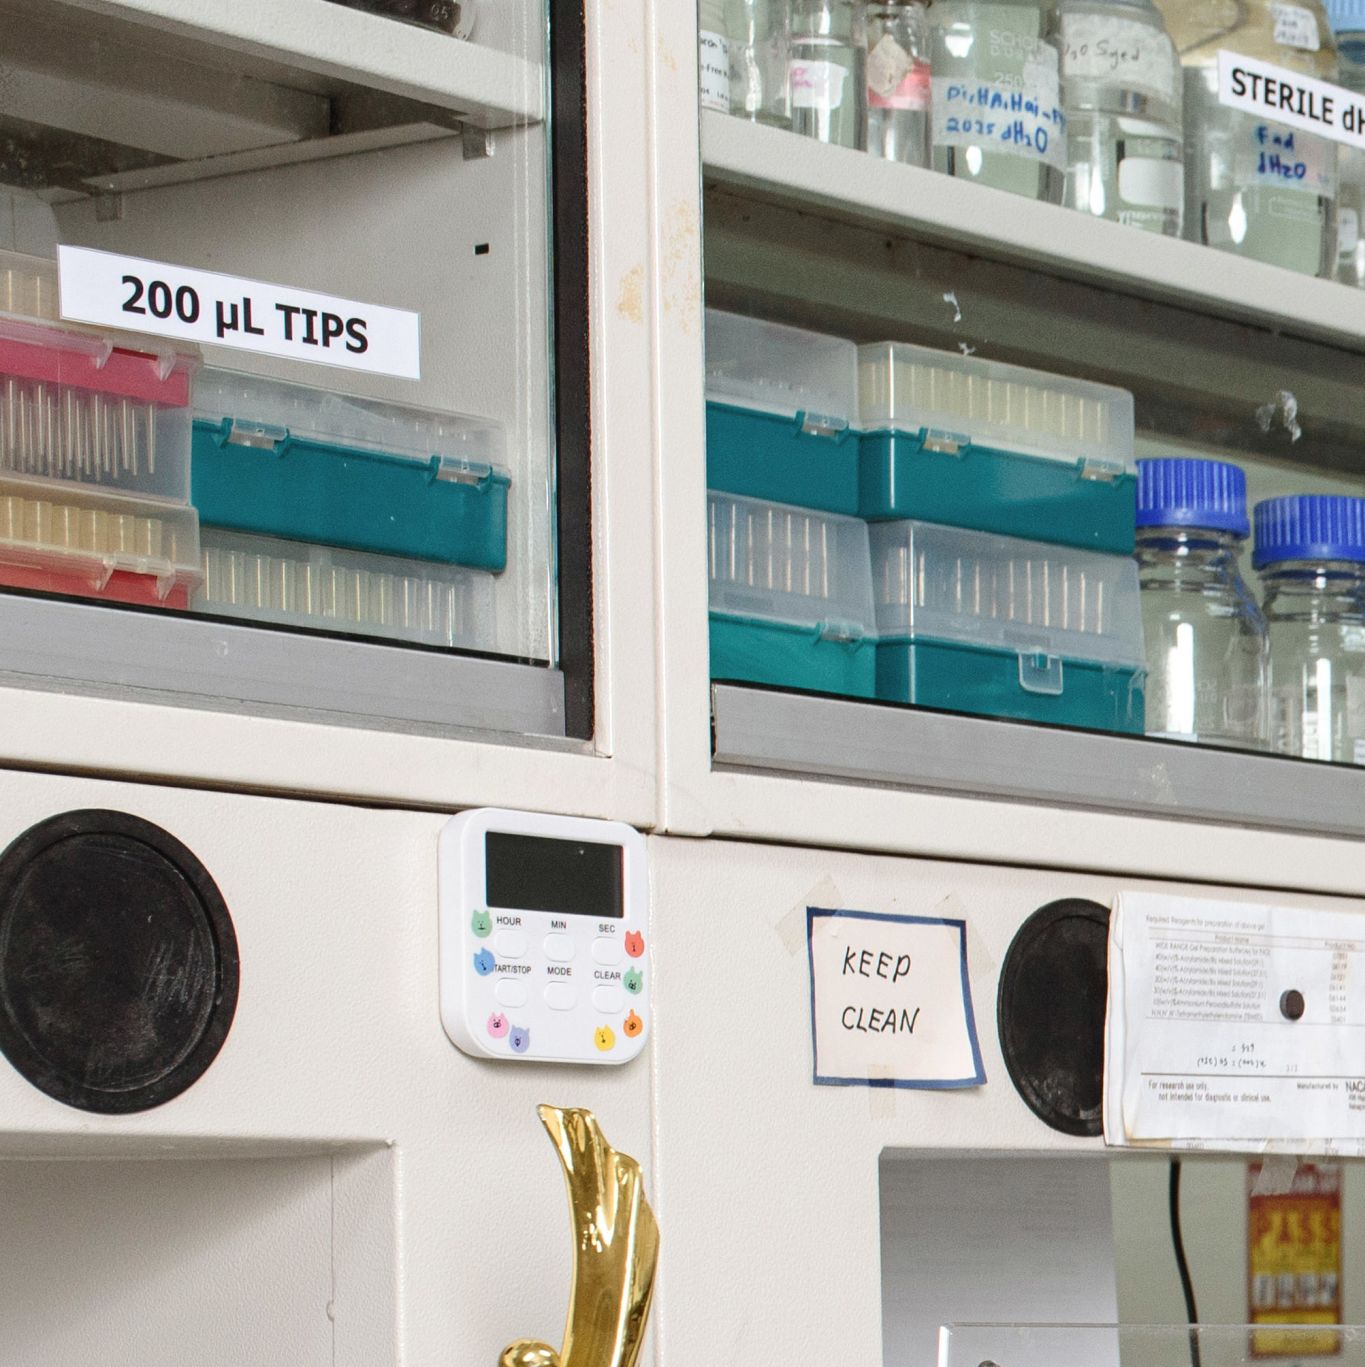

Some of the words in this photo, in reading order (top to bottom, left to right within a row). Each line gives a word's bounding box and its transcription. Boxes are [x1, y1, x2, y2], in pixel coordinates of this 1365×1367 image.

[1231, 67, 1334, 126] STERILE
[121, 274, 200, 324] 200
[275, 302, 369, 354] TIPS
[496, 916, 522, 926] HOUR
[551, 920, 567, 929] MIN
[598, 923, 616, 933] SEC
[842, 945, 911, 983] KEEP
[494, 964, 532, 975] TART/STOP
[547, 967, 572, 976] MODE
[594, 970, 621, 980] CLEAR
[841, 1005, 921, 1035] CLEAN
